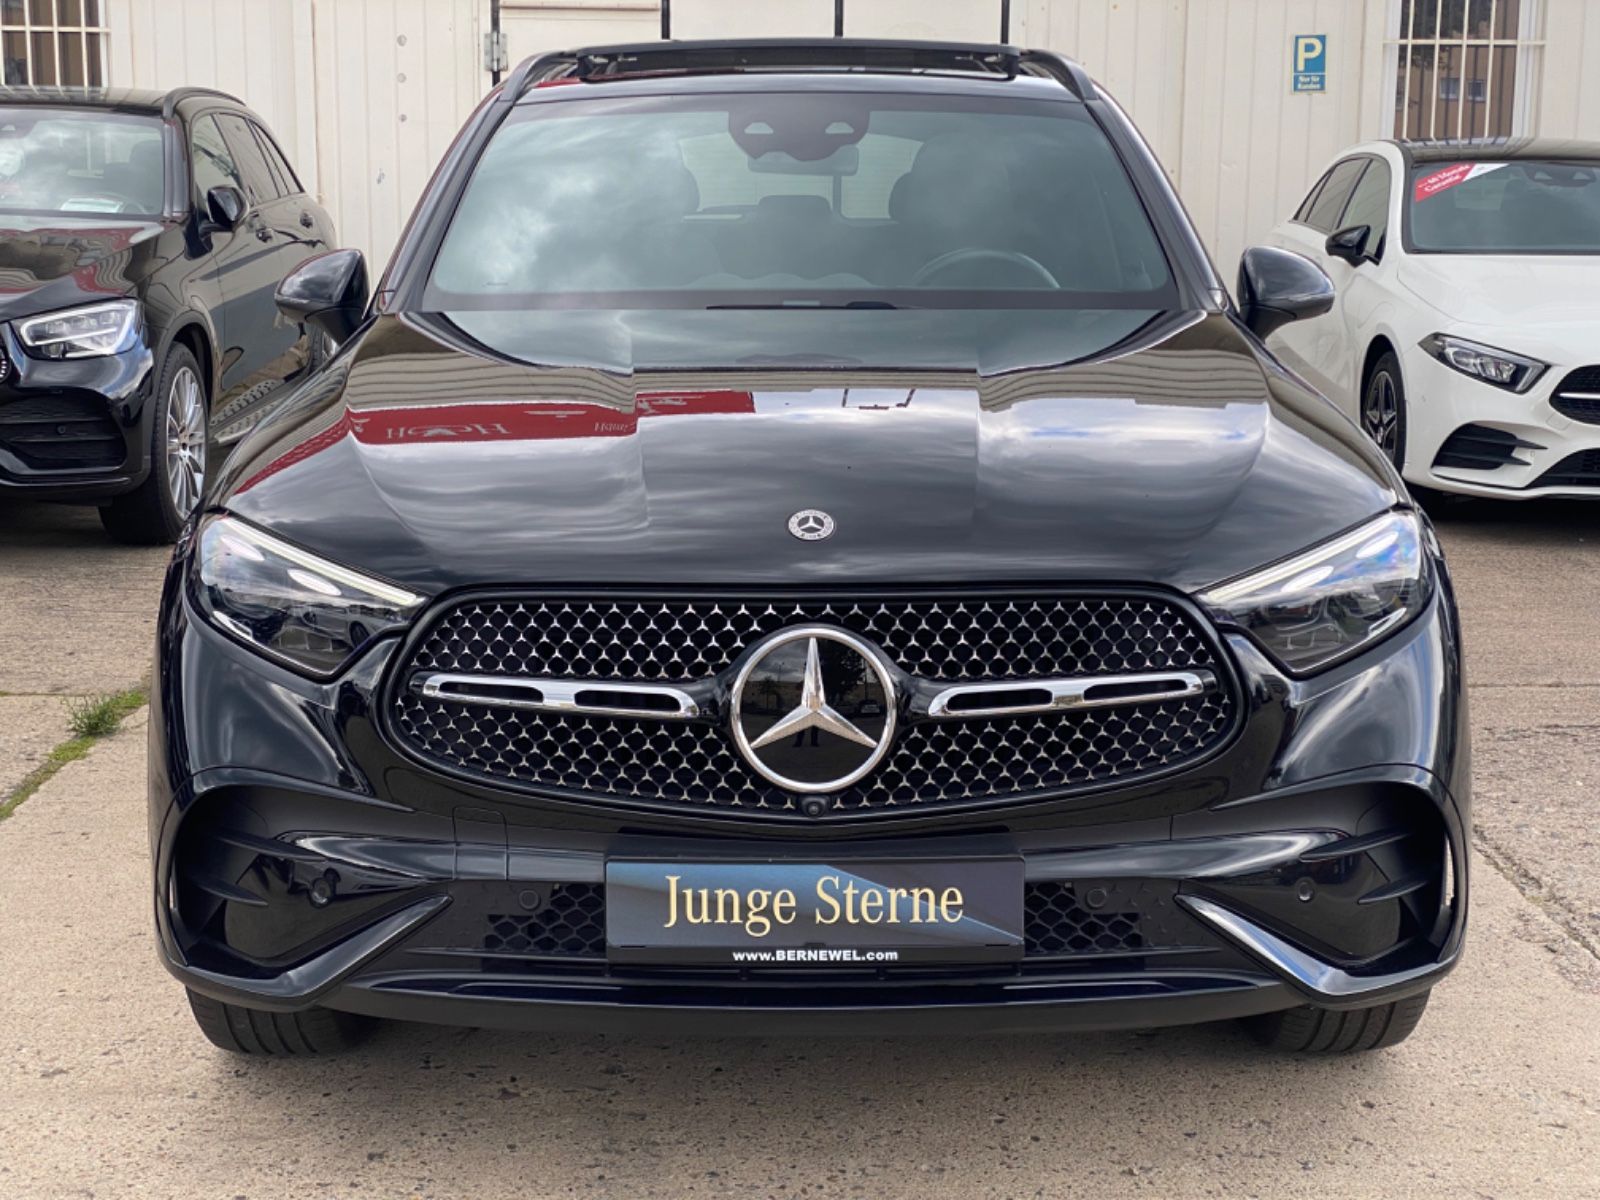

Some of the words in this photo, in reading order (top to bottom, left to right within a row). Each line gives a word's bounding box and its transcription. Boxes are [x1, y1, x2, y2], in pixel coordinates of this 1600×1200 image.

[1297, 37, 1323, 71] P
[663, 875, 797, 938] Junge
[814, 875, 964, 925] Sterne
[732, 949, 899, 962] www.BERNEWEL.com
